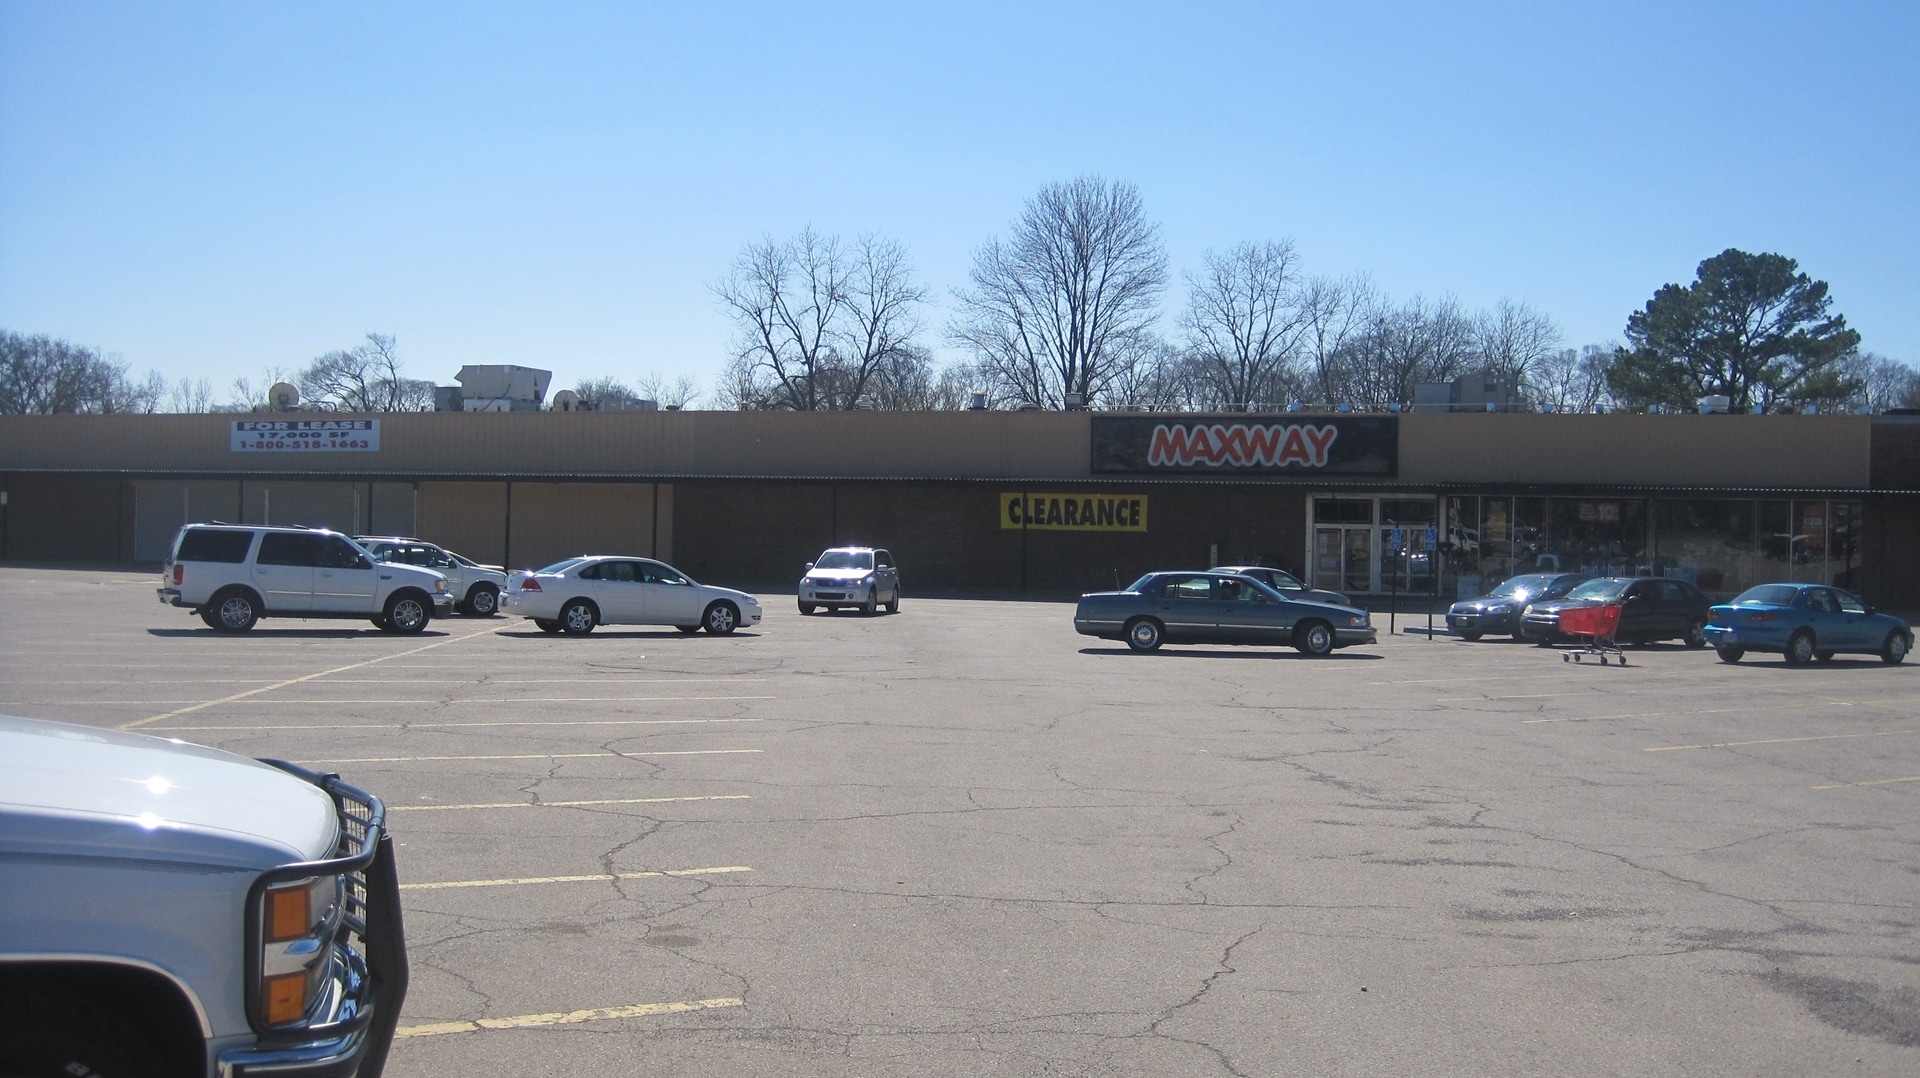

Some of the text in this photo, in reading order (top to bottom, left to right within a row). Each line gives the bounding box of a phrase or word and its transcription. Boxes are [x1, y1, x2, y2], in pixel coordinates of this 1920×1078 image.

[243, 421, 367, 430] FOR LEASE
[257, 431, 322, 439] 17,000
[240, 440, 369, 449] 1-800-518-1663
[1147, 424, 1338, 467] MAXWAY
[1008, 497, 1141, 527] CLEARANCE
